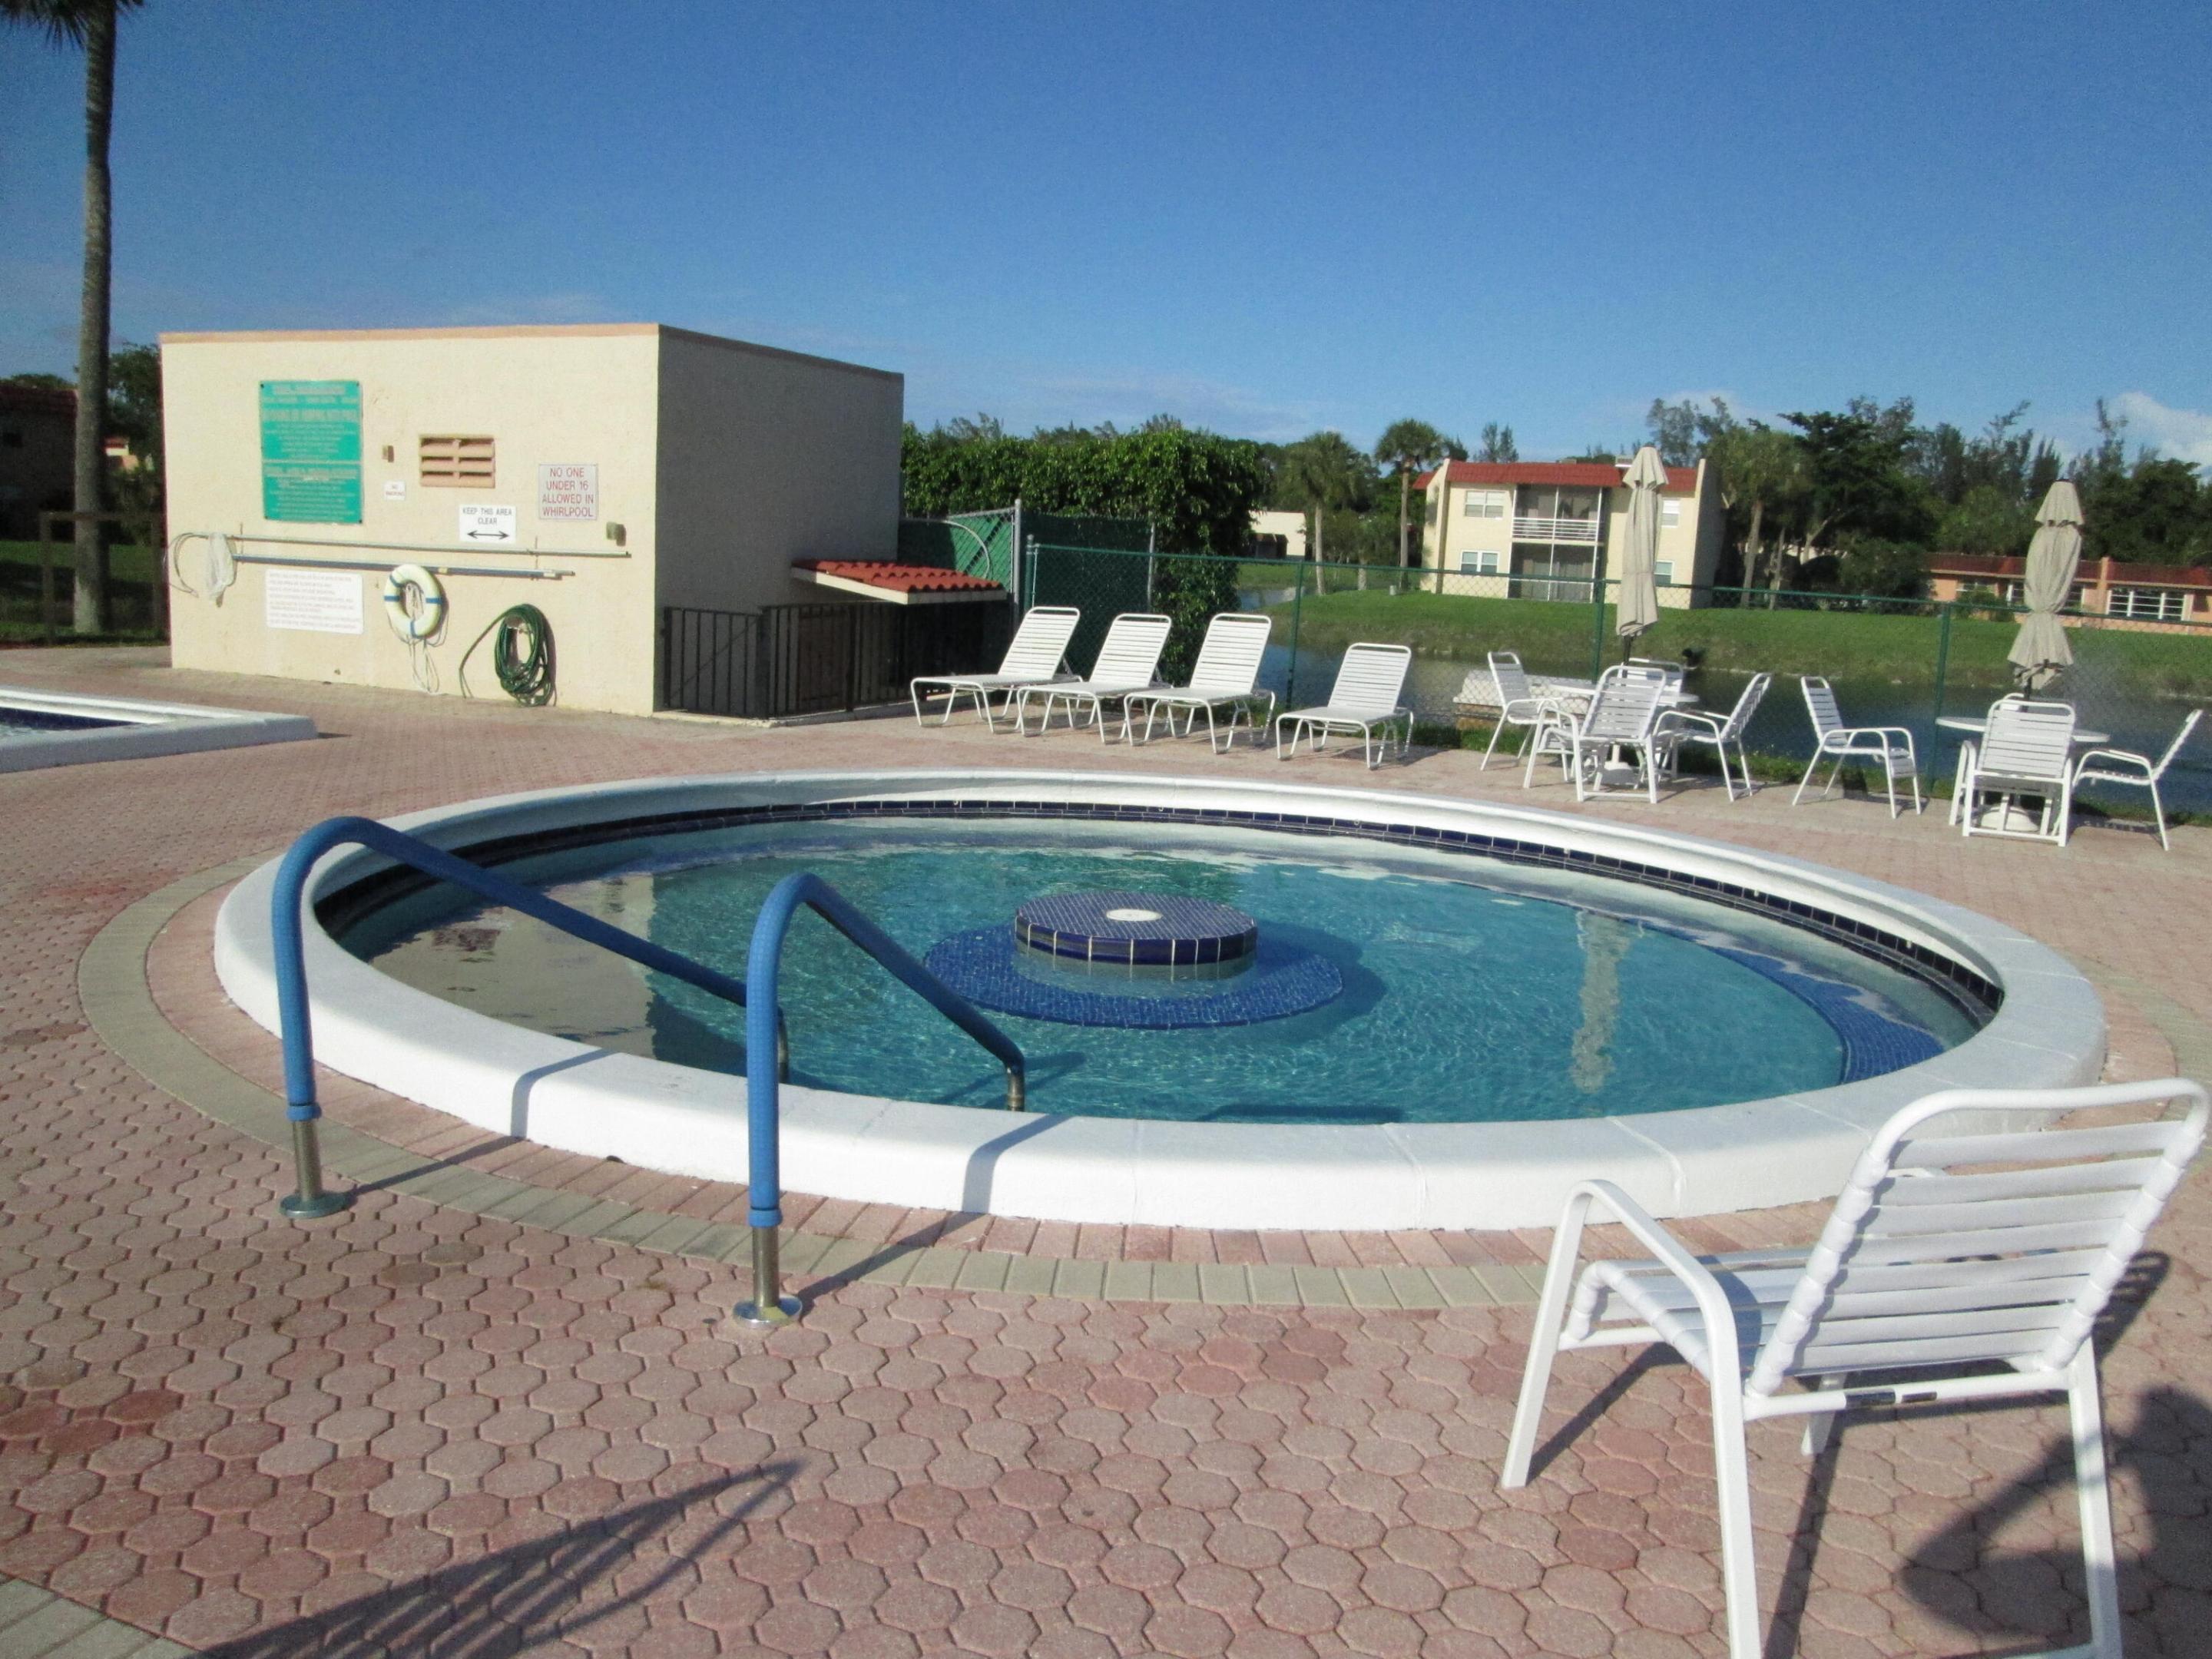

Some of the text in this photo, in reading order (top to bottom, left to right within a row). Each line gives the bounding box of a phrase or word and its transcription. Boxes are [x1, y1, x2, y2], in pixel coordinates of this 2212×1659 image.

[550, 467, 584, 477] NO ONE
[546, 480, 589, 491] UNDER 16
[541, 493, 594, 504] ALLOWED IN
[496, 508, 512, 516] AREA
[542, 506, 594, 517] WHIRLPOOL
[478, 517, 497, 525] CLEAR
